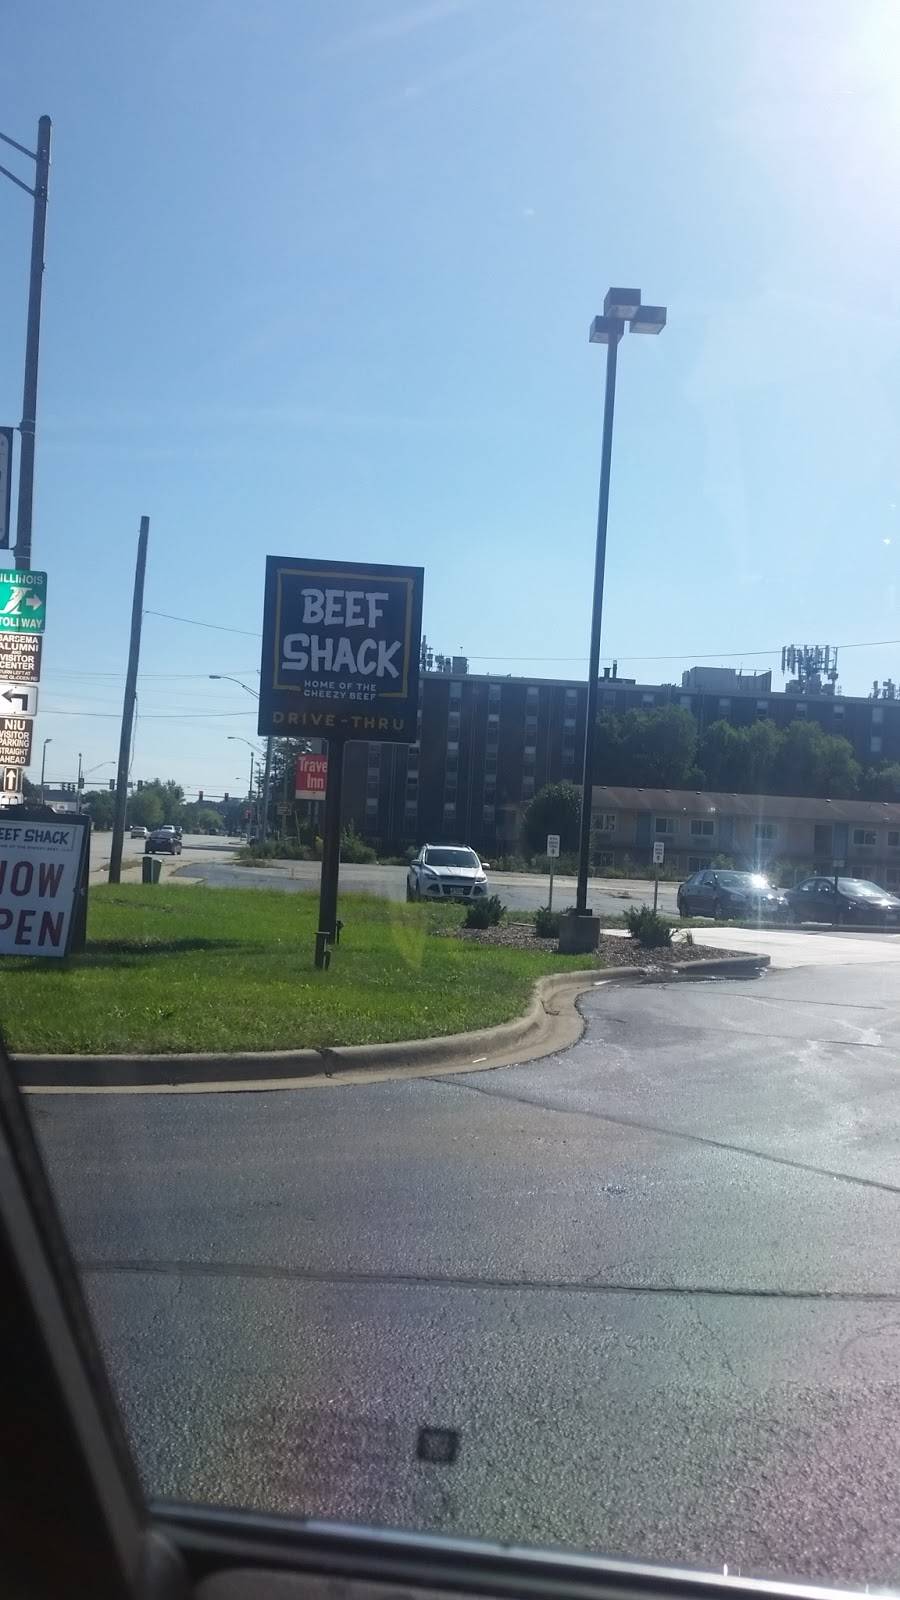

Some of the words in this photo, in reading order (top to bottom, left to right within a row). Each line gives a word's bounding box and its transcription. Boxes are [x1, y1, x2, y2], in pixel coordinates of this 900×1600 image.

[0, 573, 43, 585] ILLINOIS
[301, 588, 389, 629] BEEF
[0, 642, 39, 652] ALUMNI
[0, 653, 35, 663] VISITOR
[281, 633, 402, 679] SHACK
[0, 661, 35, 670] CENTER
[304, 680, 335, 689] HOME
[339, 682, 352, 690] OF
[356, 683, 377, 692] THE
[303, 690, 346, 699] CHEEZY
[349, 691, 377, 701] BEEF
[4, 719, 26, 731] NIU
[0, 730, 30, 740] VISITOR
[0, 746, 28, 756] TRAIGHT
[0, 755, 26, 764] AHEAD
[299, 756, 328, 773] Trave
[307, 772, 324, 789] Inn
[0, 827, 22, 841] EEF
[24, 828, 70, 845] SHACK
[0, 907, 65, 947] PEN
